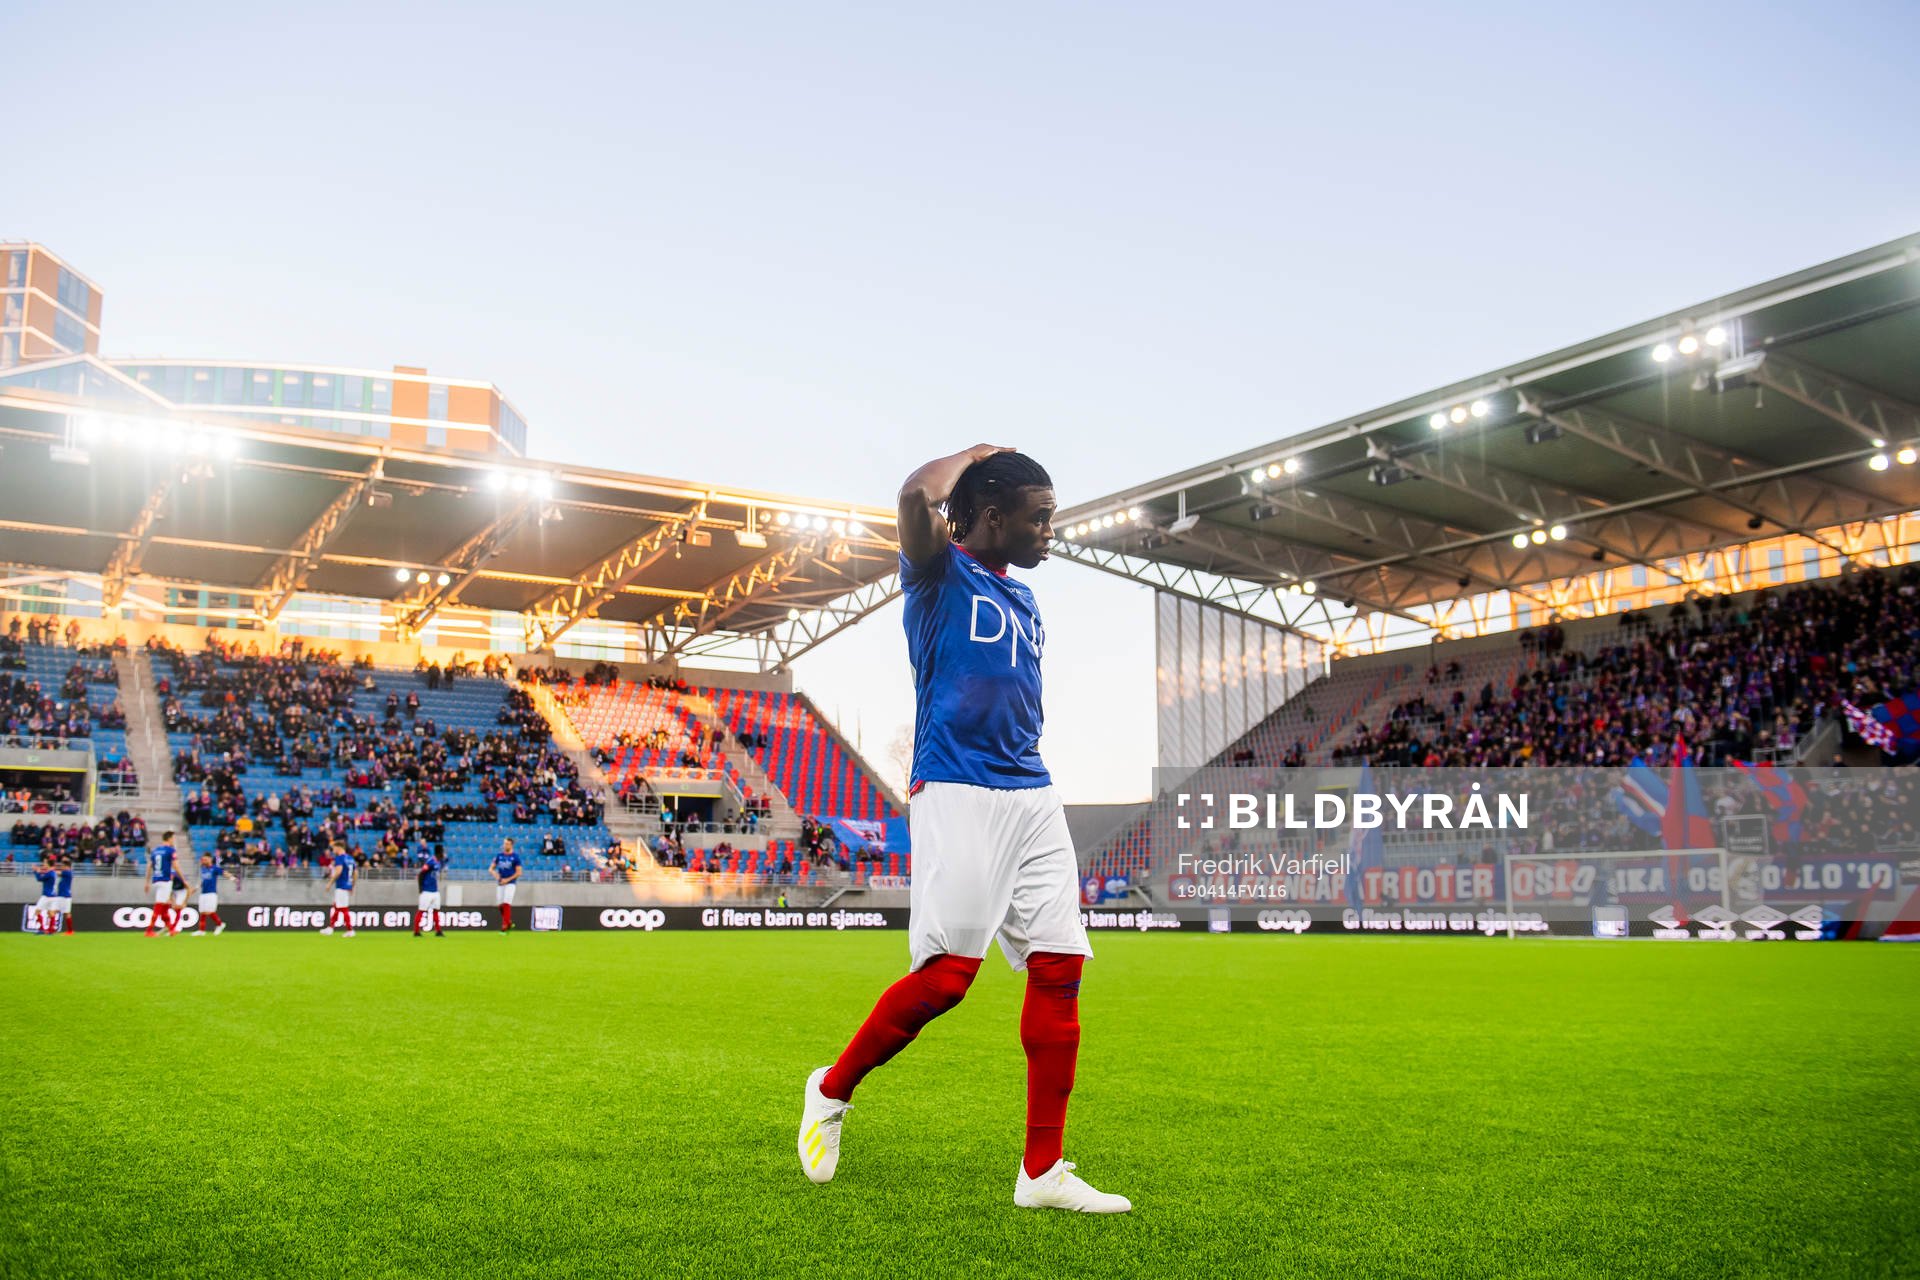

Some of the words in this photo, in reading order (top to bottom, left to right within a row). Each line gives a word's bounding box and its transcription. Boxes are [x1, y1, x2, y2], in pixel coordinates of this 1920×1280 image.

[1761, 864, 1843, 890] OLO
[247, 907, 270, 928] Gi
[383, 911, 411, 928] en
[599, 908, 665, 931] coop
[701, 909, 719, 927] Gi
[764, 909, 804, 927] barn
[807, 912, 828, 927] en
[830, 909, 888, 931] sjanse.
[1089, 910, 1117, 927] barn
[1118, 913, 1135, 928] en
[1257, 910, 1312, 934] coop
